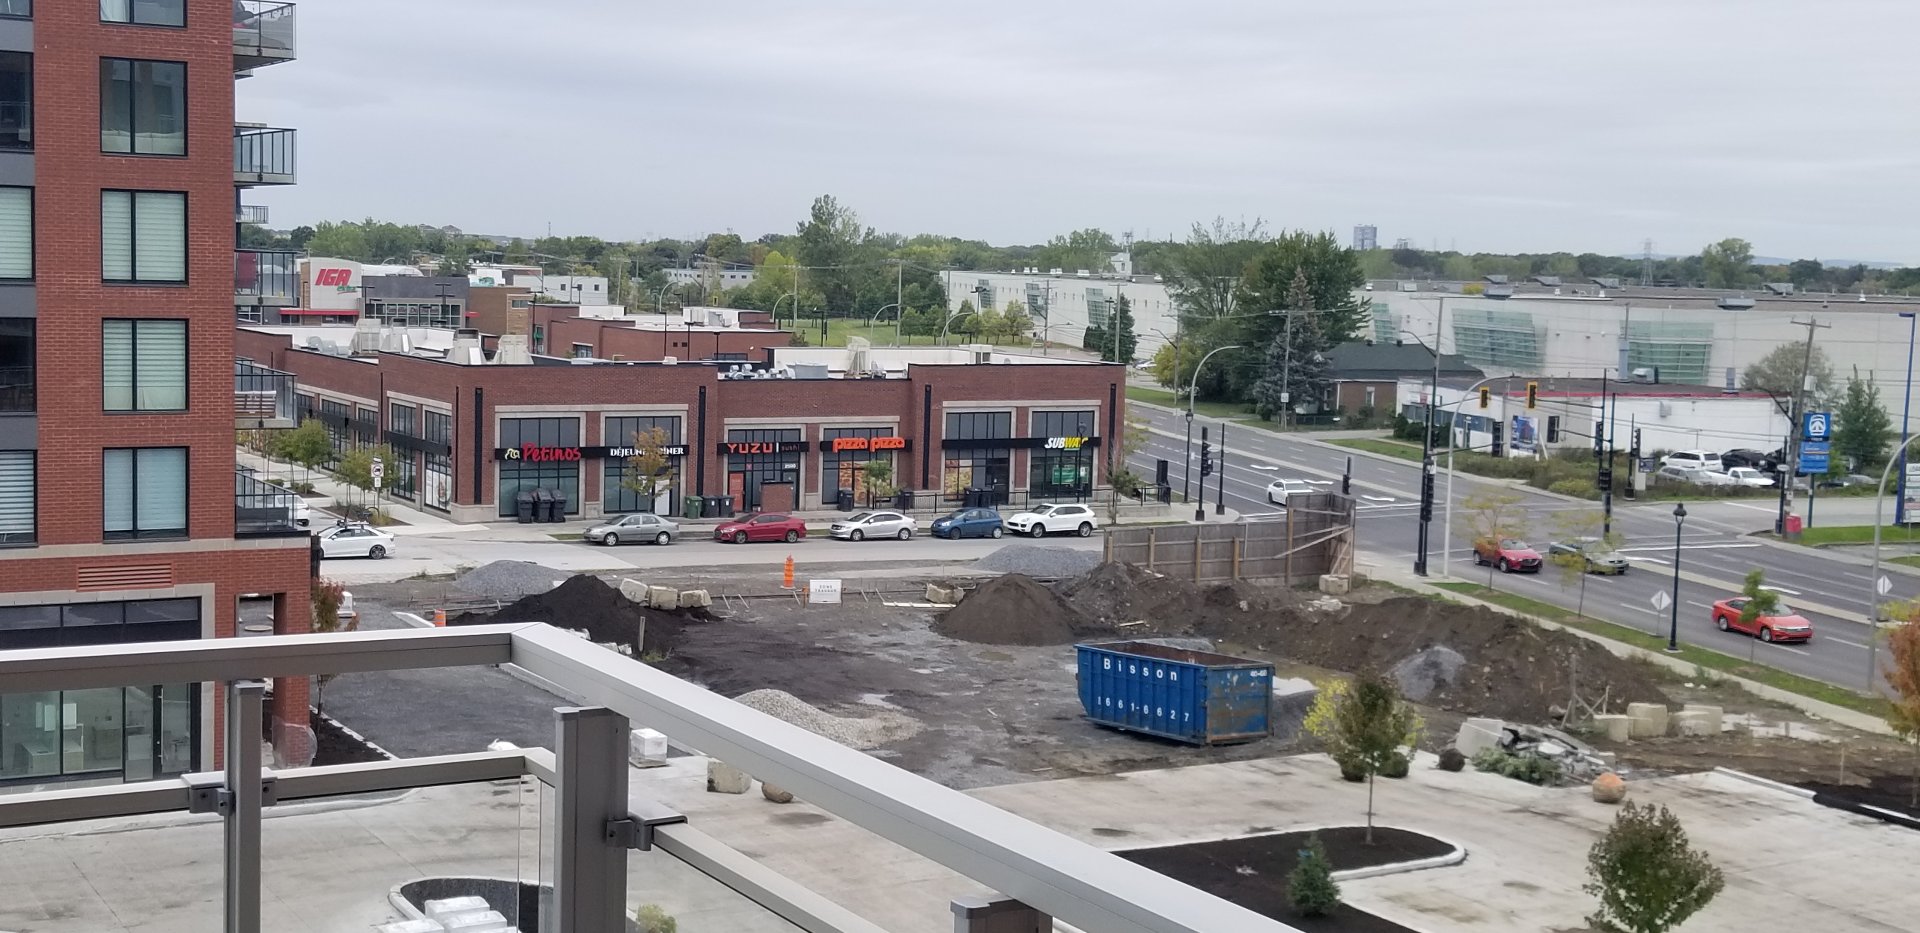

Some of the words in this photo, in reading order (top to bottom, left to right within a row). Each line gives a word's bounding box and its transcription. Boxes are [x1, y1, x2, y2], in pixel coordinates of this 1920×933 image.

[315, 268, 352, 286] IGA
[522, 442, 581, 462] Petinos
[610, 447, 650, 457] DÉJEUNE
[727, 443, 773, 453] YUZU
[832, 438, 868, 453] pizza
[870, 437, 905, 453] pizza
[1103, 658, 1177, 681] Bisson
